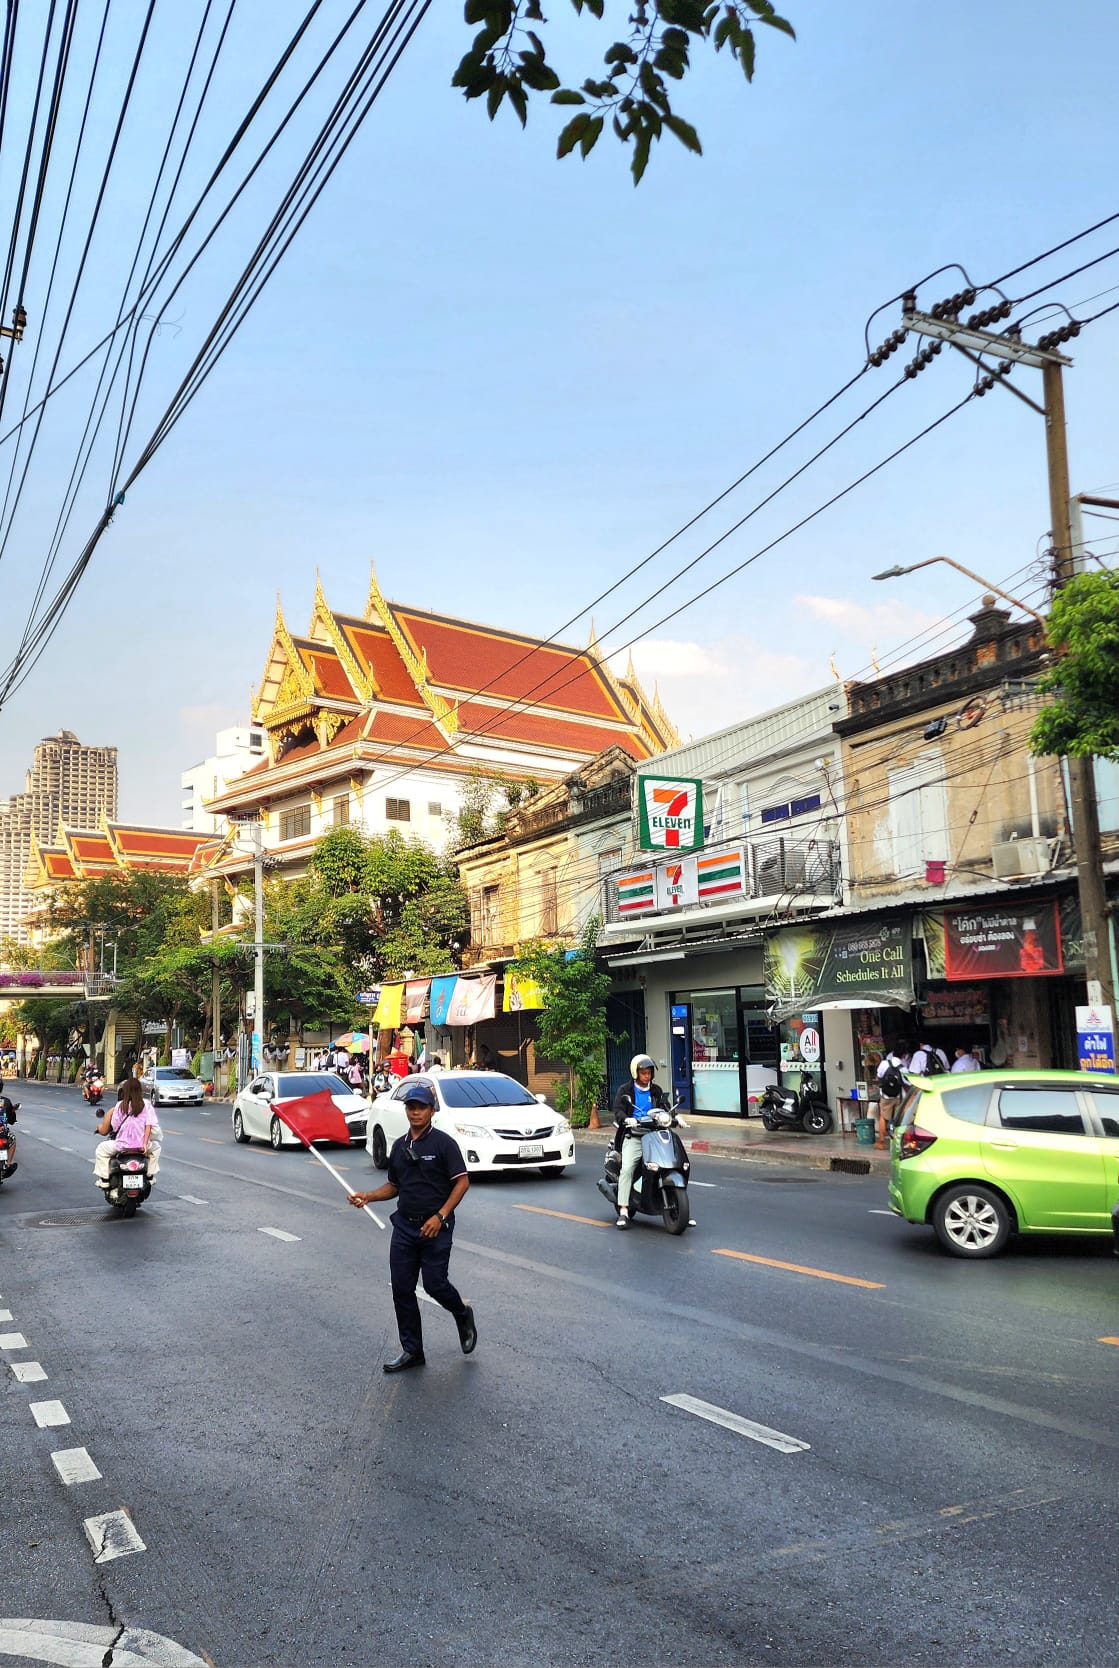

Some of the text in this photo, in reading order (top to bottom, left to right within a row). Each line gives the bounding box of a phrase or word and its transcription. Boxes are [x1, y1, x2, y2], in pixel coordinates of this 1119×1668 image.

[653, 788, 688, 846] 7
[861, 946, 904, 963] One Call
[837, 965, 904, 982] Schedules It All
[804, 1031, 816, 1047] All
